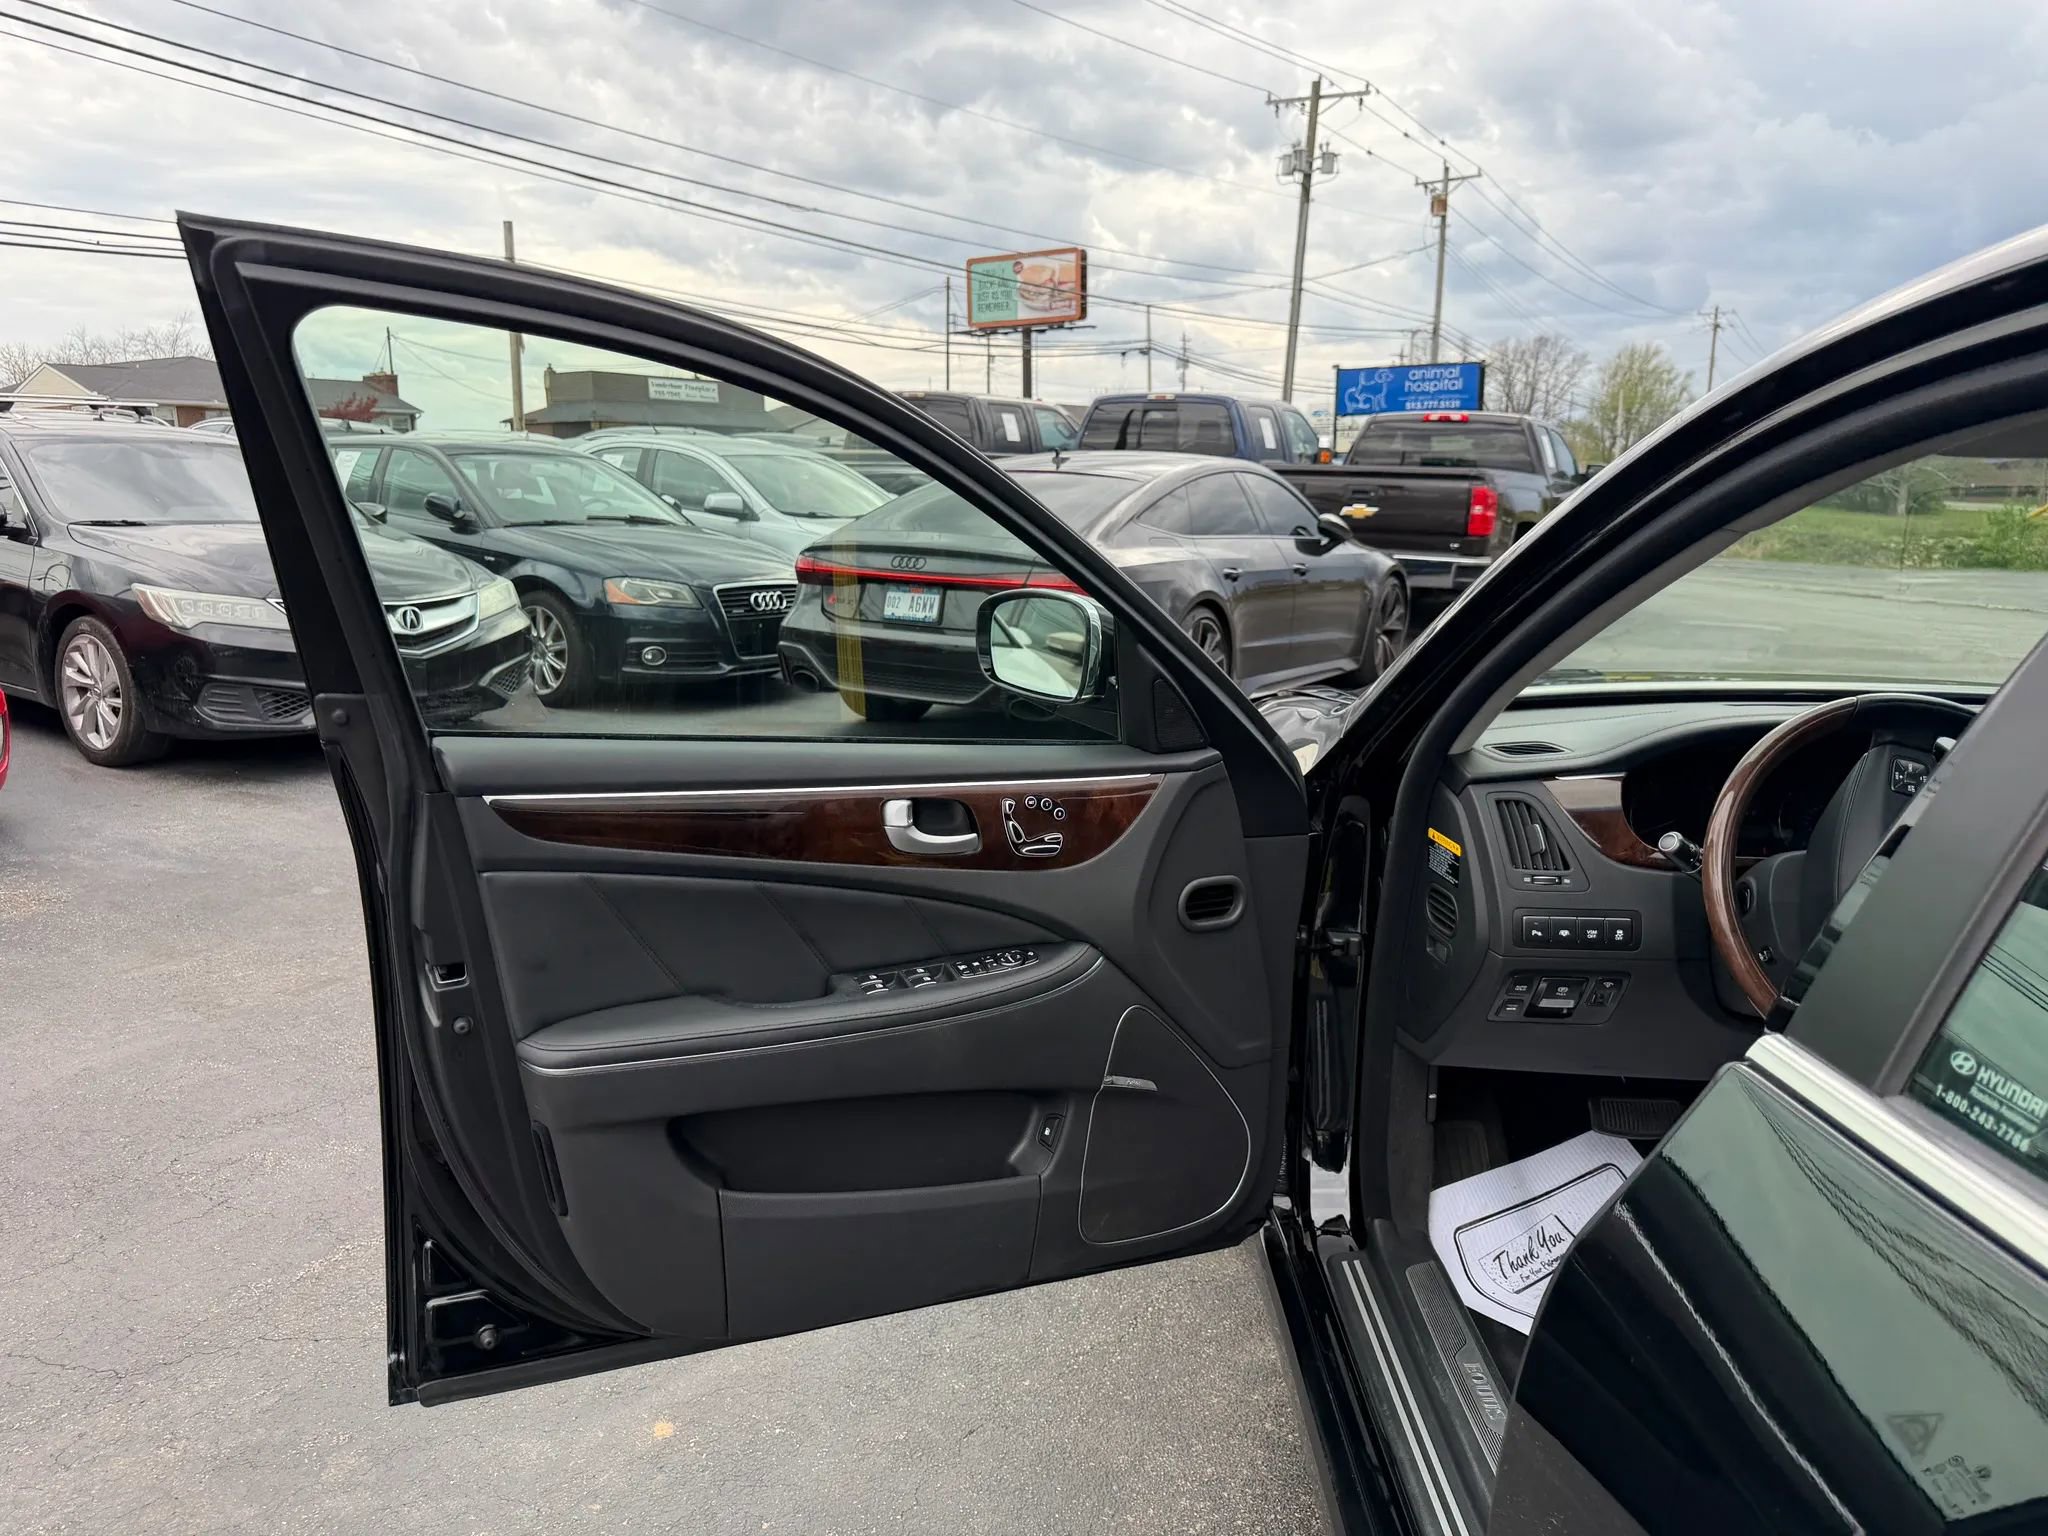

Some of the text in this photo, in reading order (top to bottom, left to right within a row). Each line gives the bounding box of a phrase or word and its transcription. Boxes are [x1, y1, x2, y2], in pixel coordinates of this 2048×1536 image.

[1404, 377, 1463, 393] hospital
[1408, 365, 1460, 380] animal
[1976, 1065, 2048, 1119] HYUNDAI
[1492, 1225, 1566, 1280] Thank You
